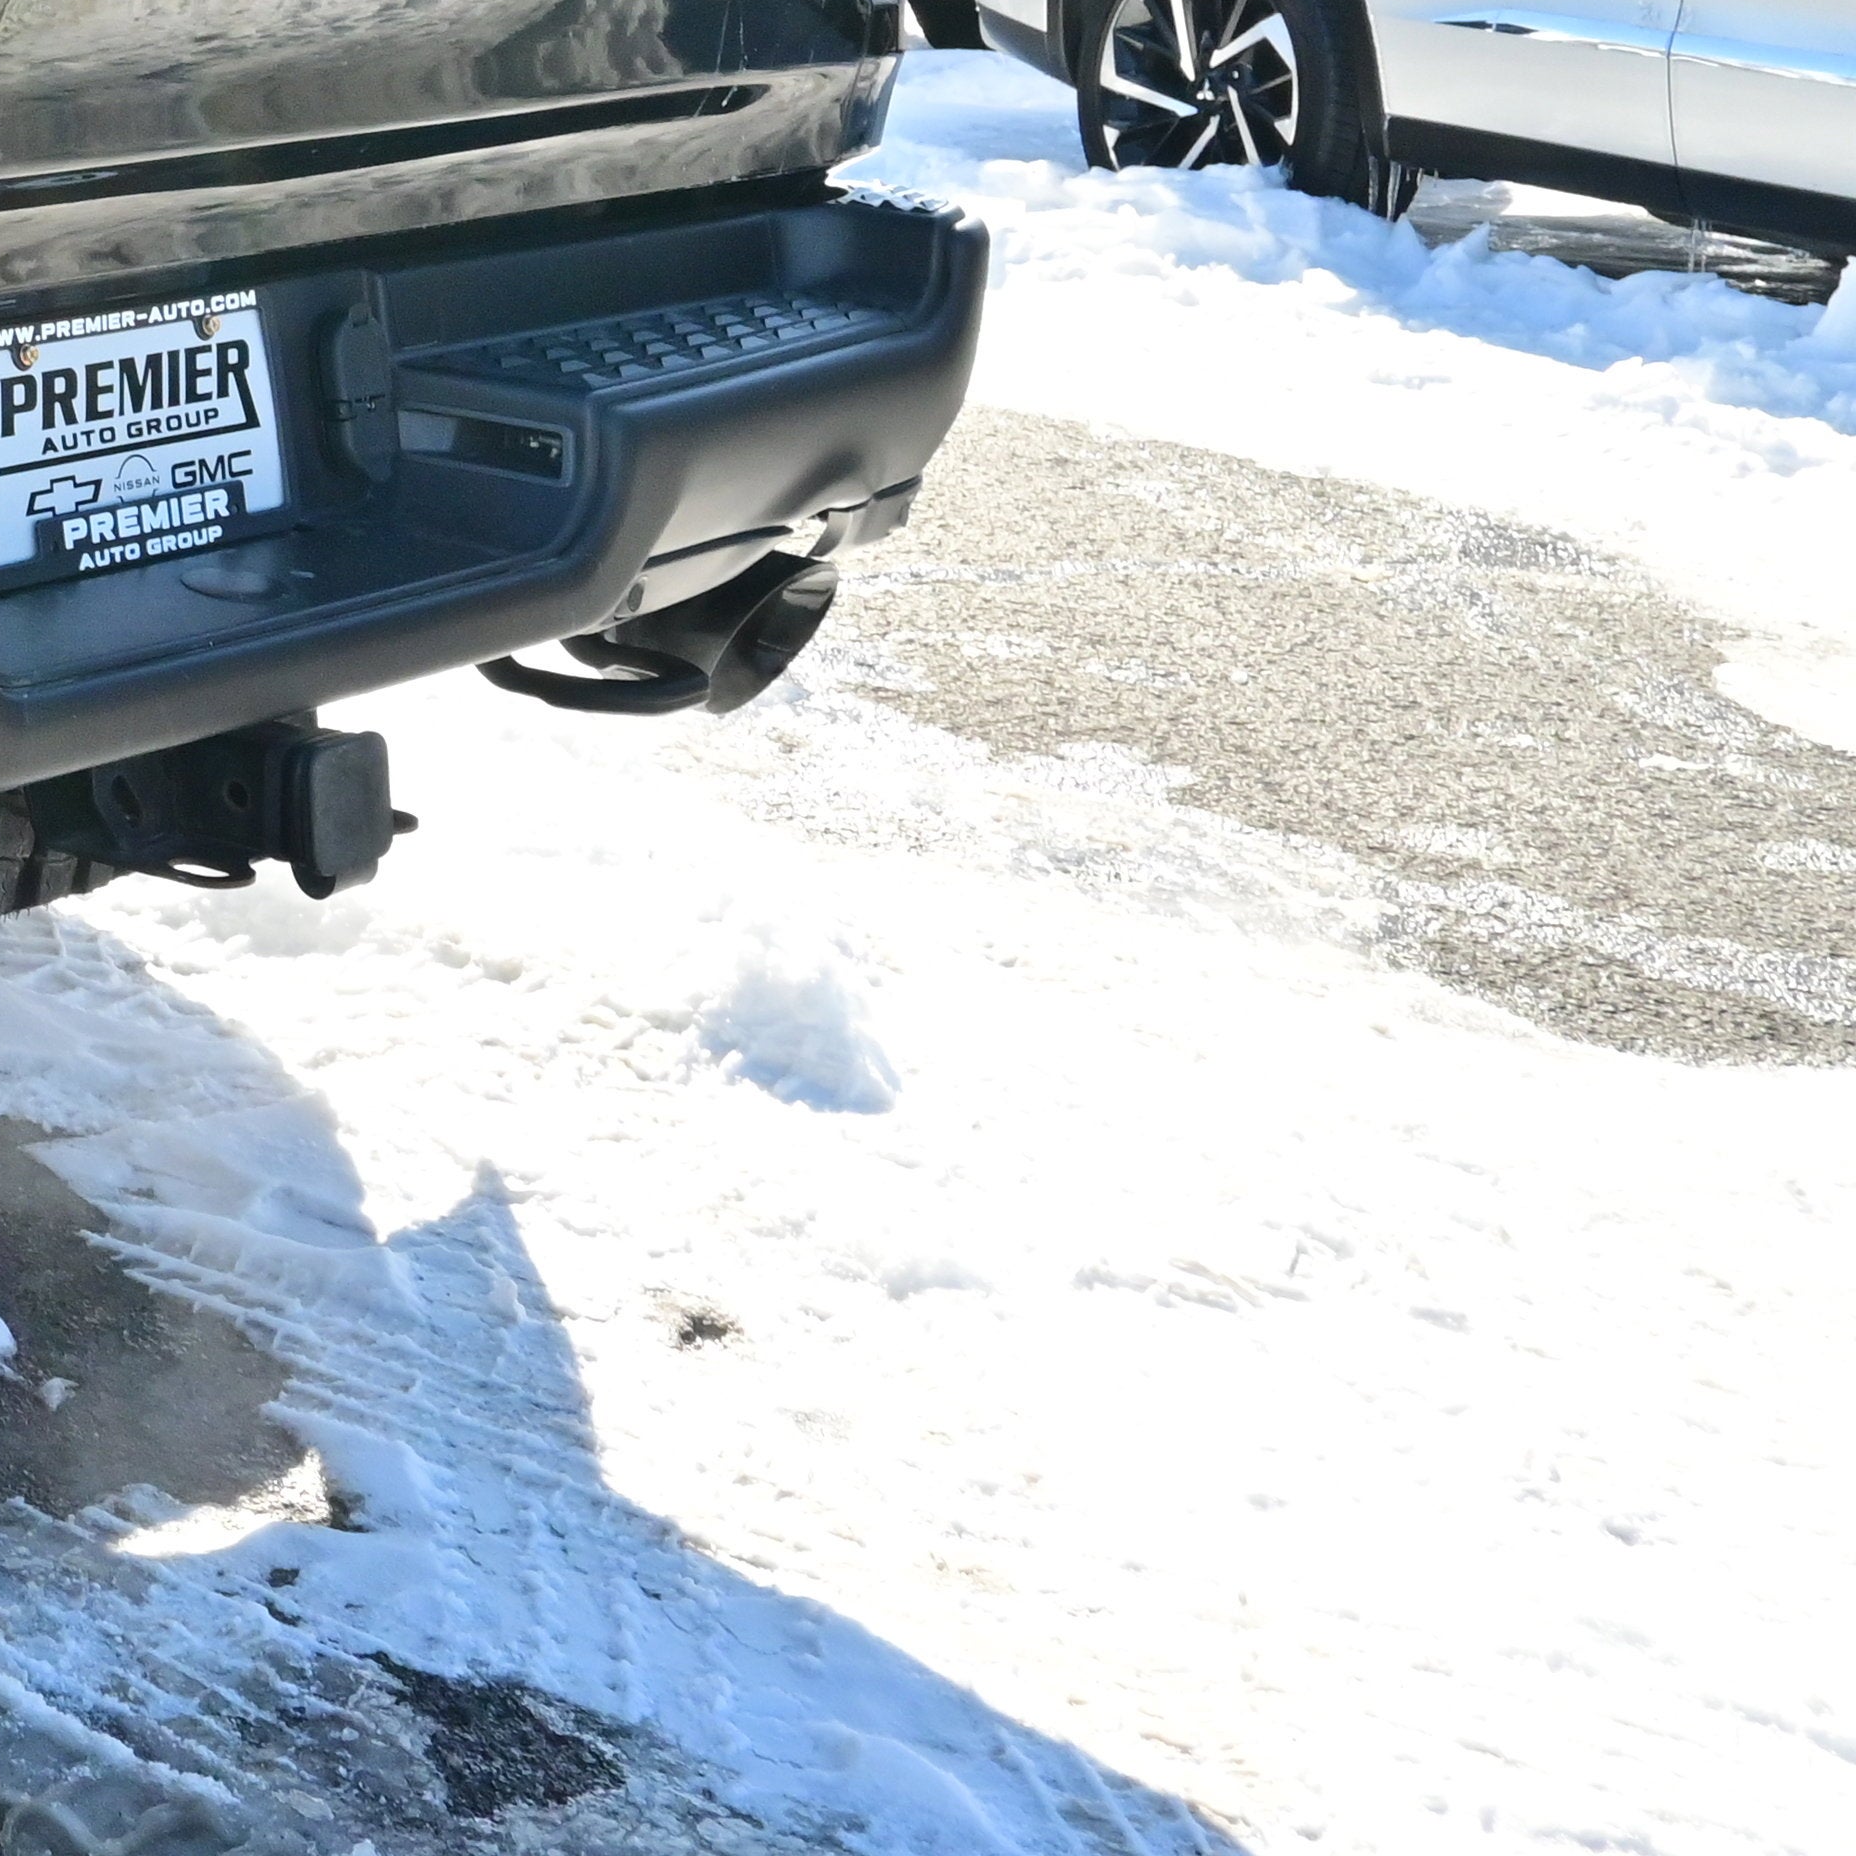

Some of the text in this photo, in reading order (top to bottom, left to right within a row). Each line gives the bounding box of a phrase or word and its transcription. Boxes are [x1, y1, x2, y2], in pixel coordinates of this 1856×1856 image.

[0, 339, 256, 438] PREMIER
[41, 407, 220, 455] AUTO GROUP
[113, 450, 253, 492] NISSAN GMC
[62, 488, 230, 550] PREMIER
[78, 525, 223, 571] AUTO GROUP
